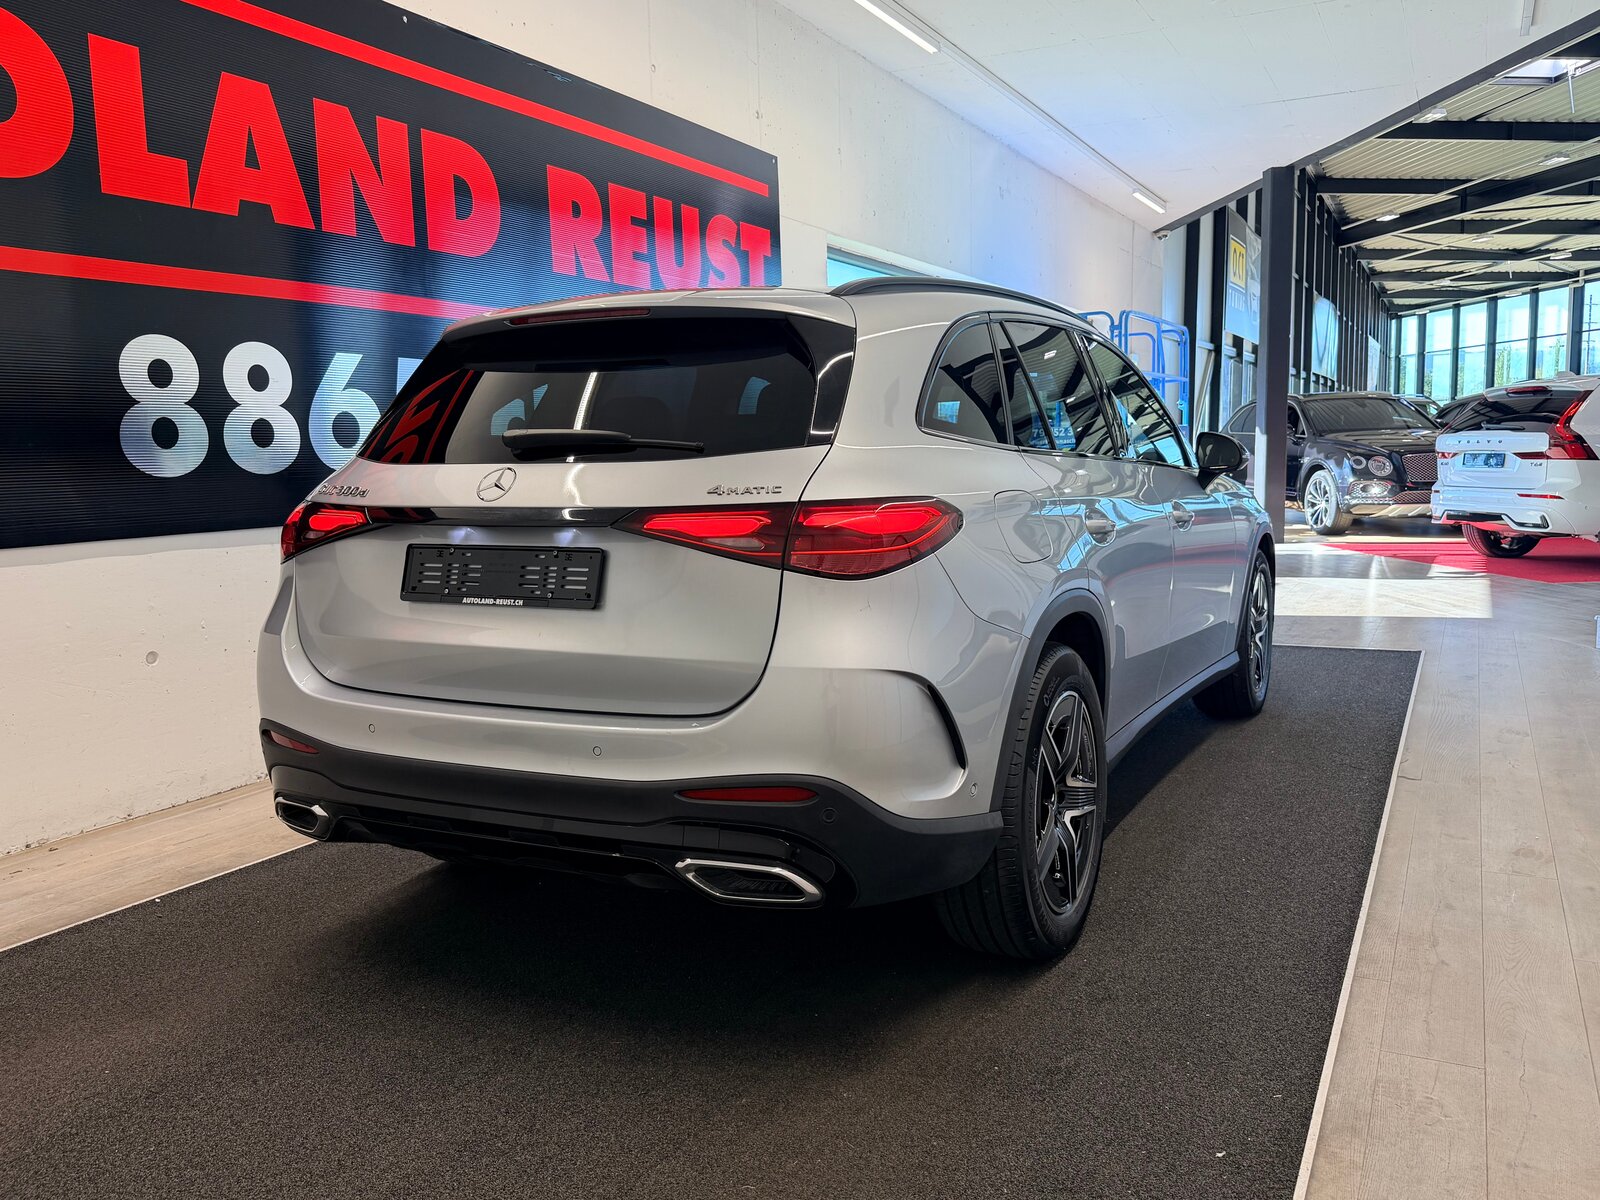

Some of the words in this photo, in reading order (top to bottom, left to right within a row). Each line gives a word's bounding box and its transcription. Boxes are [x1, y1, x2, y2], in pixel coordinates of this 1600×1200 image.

[546, 164, 772, 288] REUST
[118, 333, 421, 478] 886
[706, 484, 782, 496] 4MATIC
[462, 596, 524, 607] AUTOLAND-REUST.CH
